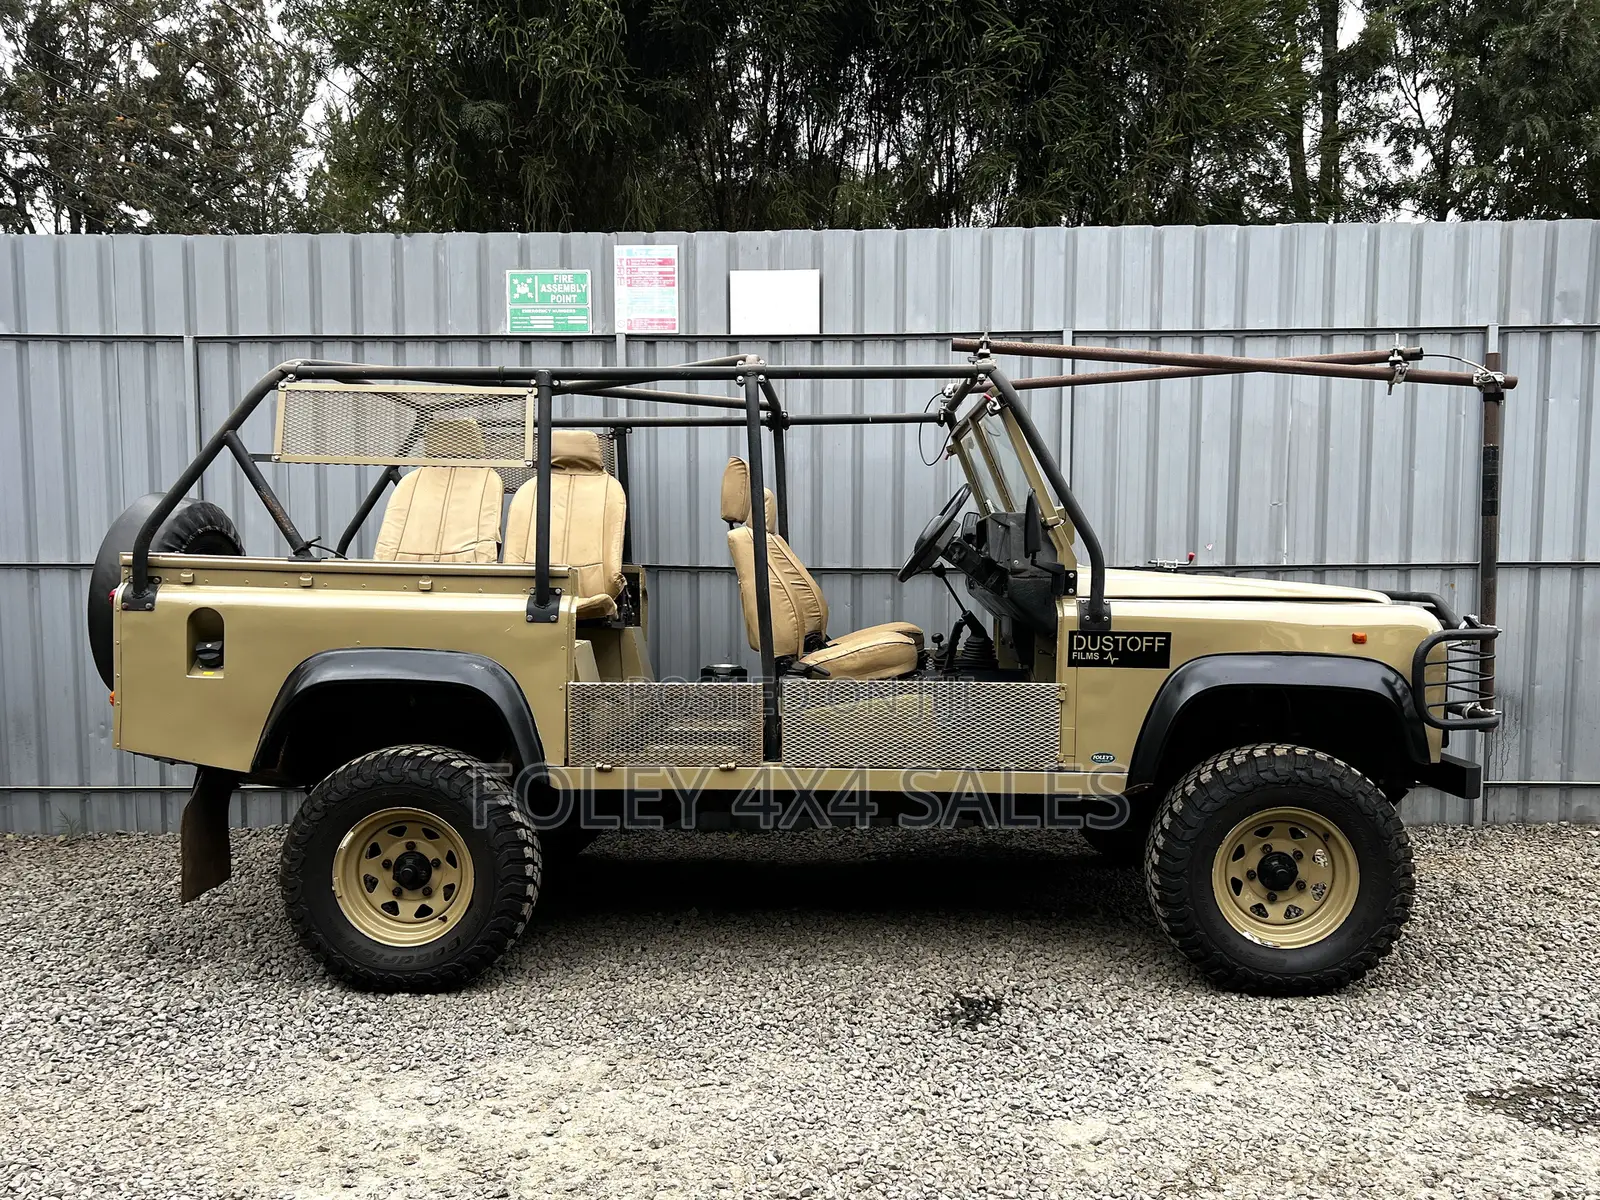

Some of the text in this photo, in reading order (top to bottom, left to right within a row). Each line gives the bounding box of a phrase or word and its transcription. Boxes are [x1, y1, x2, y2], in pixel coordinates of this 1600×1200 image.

[553, 274, 574, 283] FIRE
[540, 284, 587, 293] ASSEMBLY
[550, 294, 578, 303] POINT
[1073, 635, 1166, 652] DUSTOFF
[1072, 652, 1100, 660] FILMS
